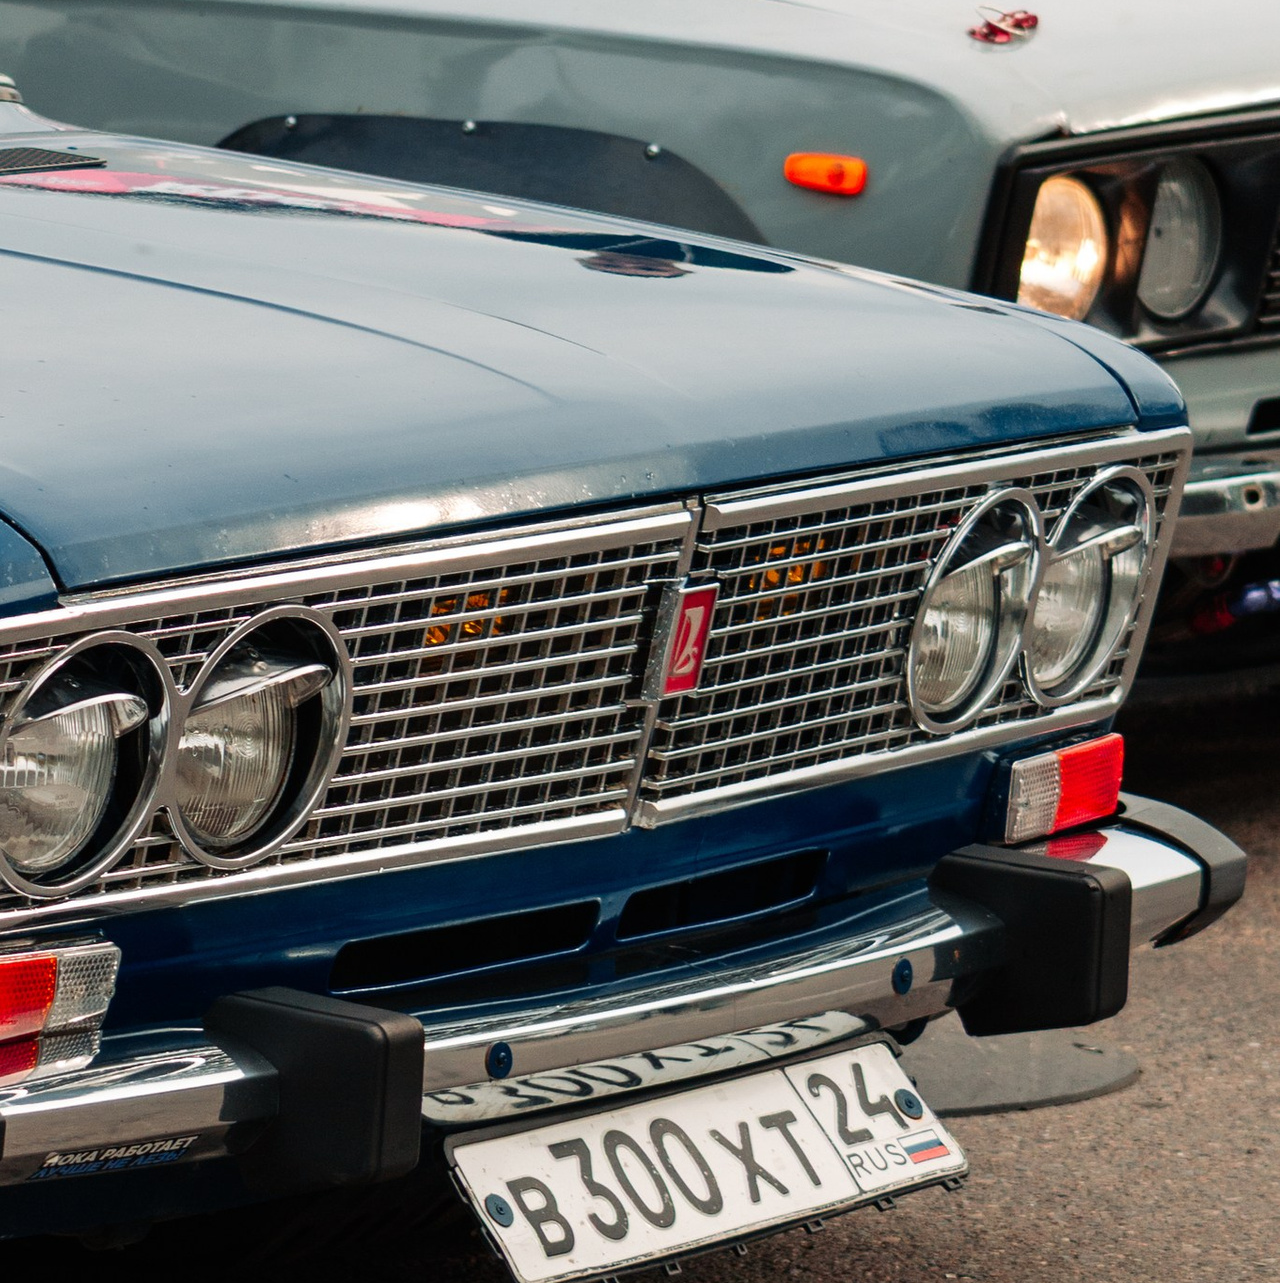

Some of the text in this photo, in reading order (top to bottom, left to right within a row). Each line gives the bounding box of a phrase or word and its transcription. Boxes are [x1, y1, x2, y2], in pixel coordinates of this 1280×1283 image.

[807, 1062, 910, 1145] 24
[99, 1135, 200, 1161] РАБОТАЕТ
[846, 1143, 908, 1179] RUS
[32, 1159, 104, 1179] ЛУЧШЕ
[103, 1156, 129, 1171] НЕ
